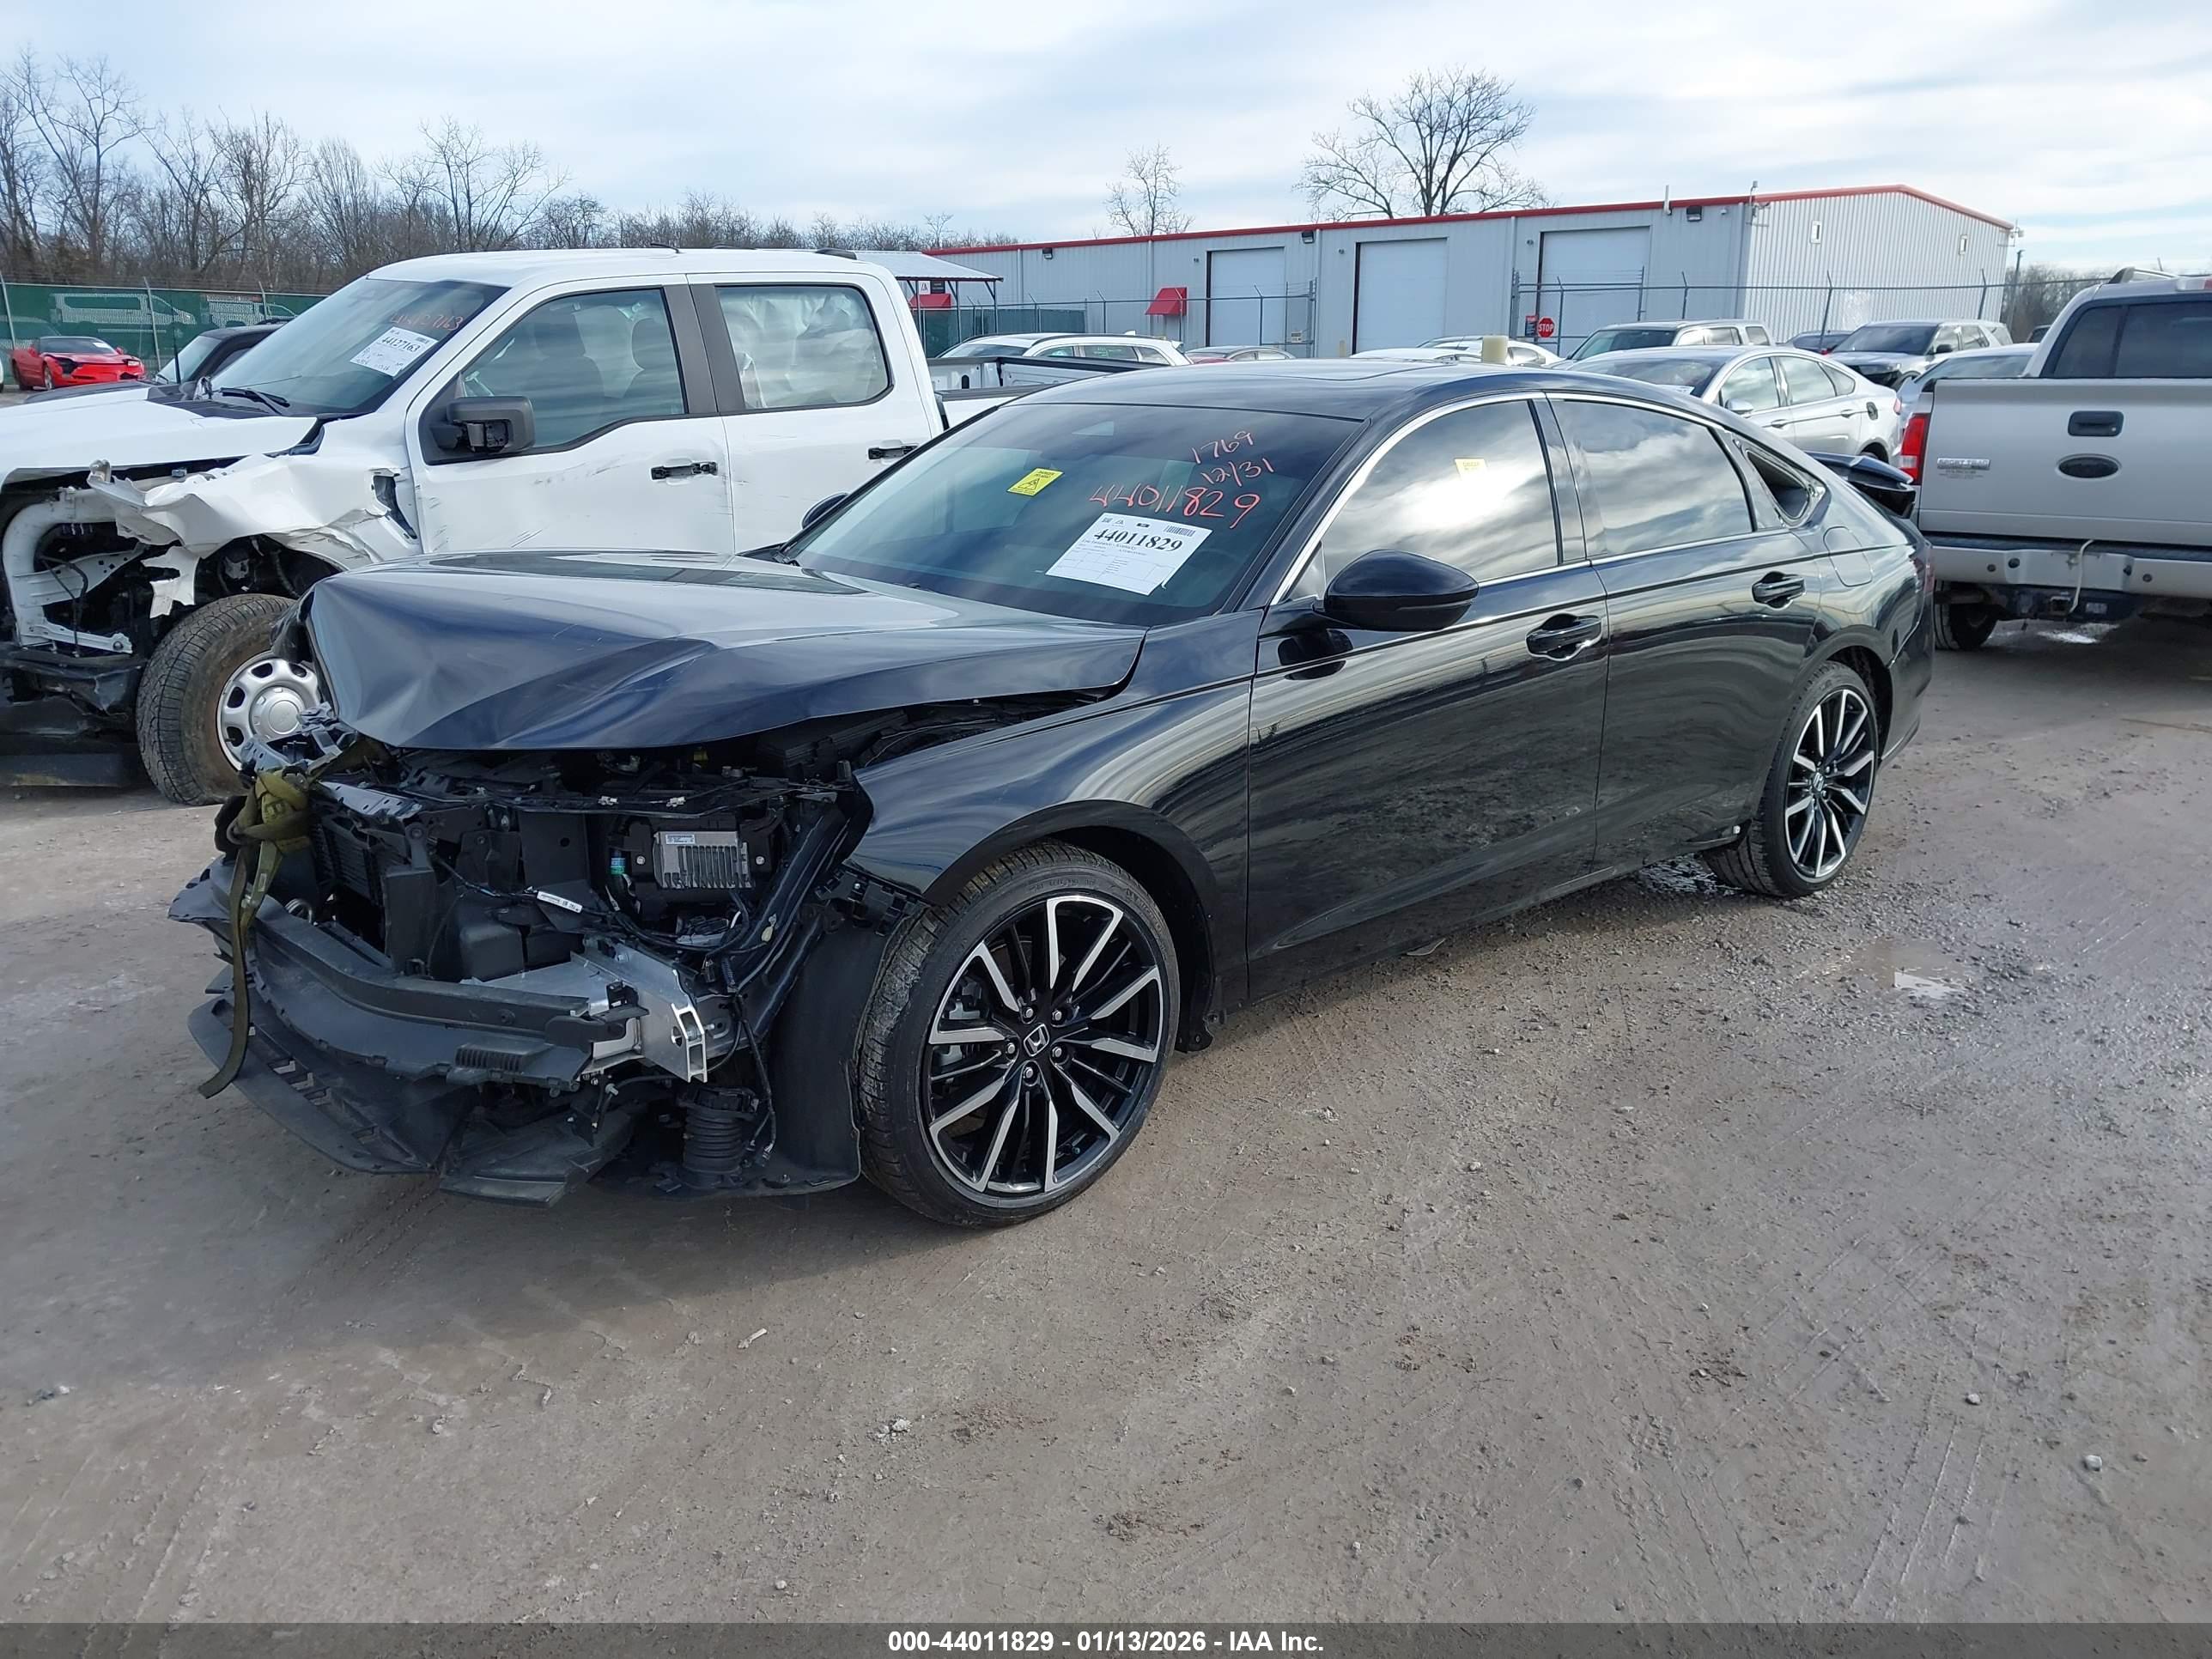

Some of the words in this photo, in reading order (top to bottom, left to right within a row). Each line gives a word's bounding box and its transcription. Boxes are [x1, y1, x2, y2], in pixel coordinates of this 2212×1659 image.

[1539, 324, 1554, 332] STOP
[1191, 431, 1253, 464] 1769
[1200, 458, 1274, 487] 12/31
[1089, 483, 1261, 529] 44011829
[1093, 528, 1183, 552] 44011829
